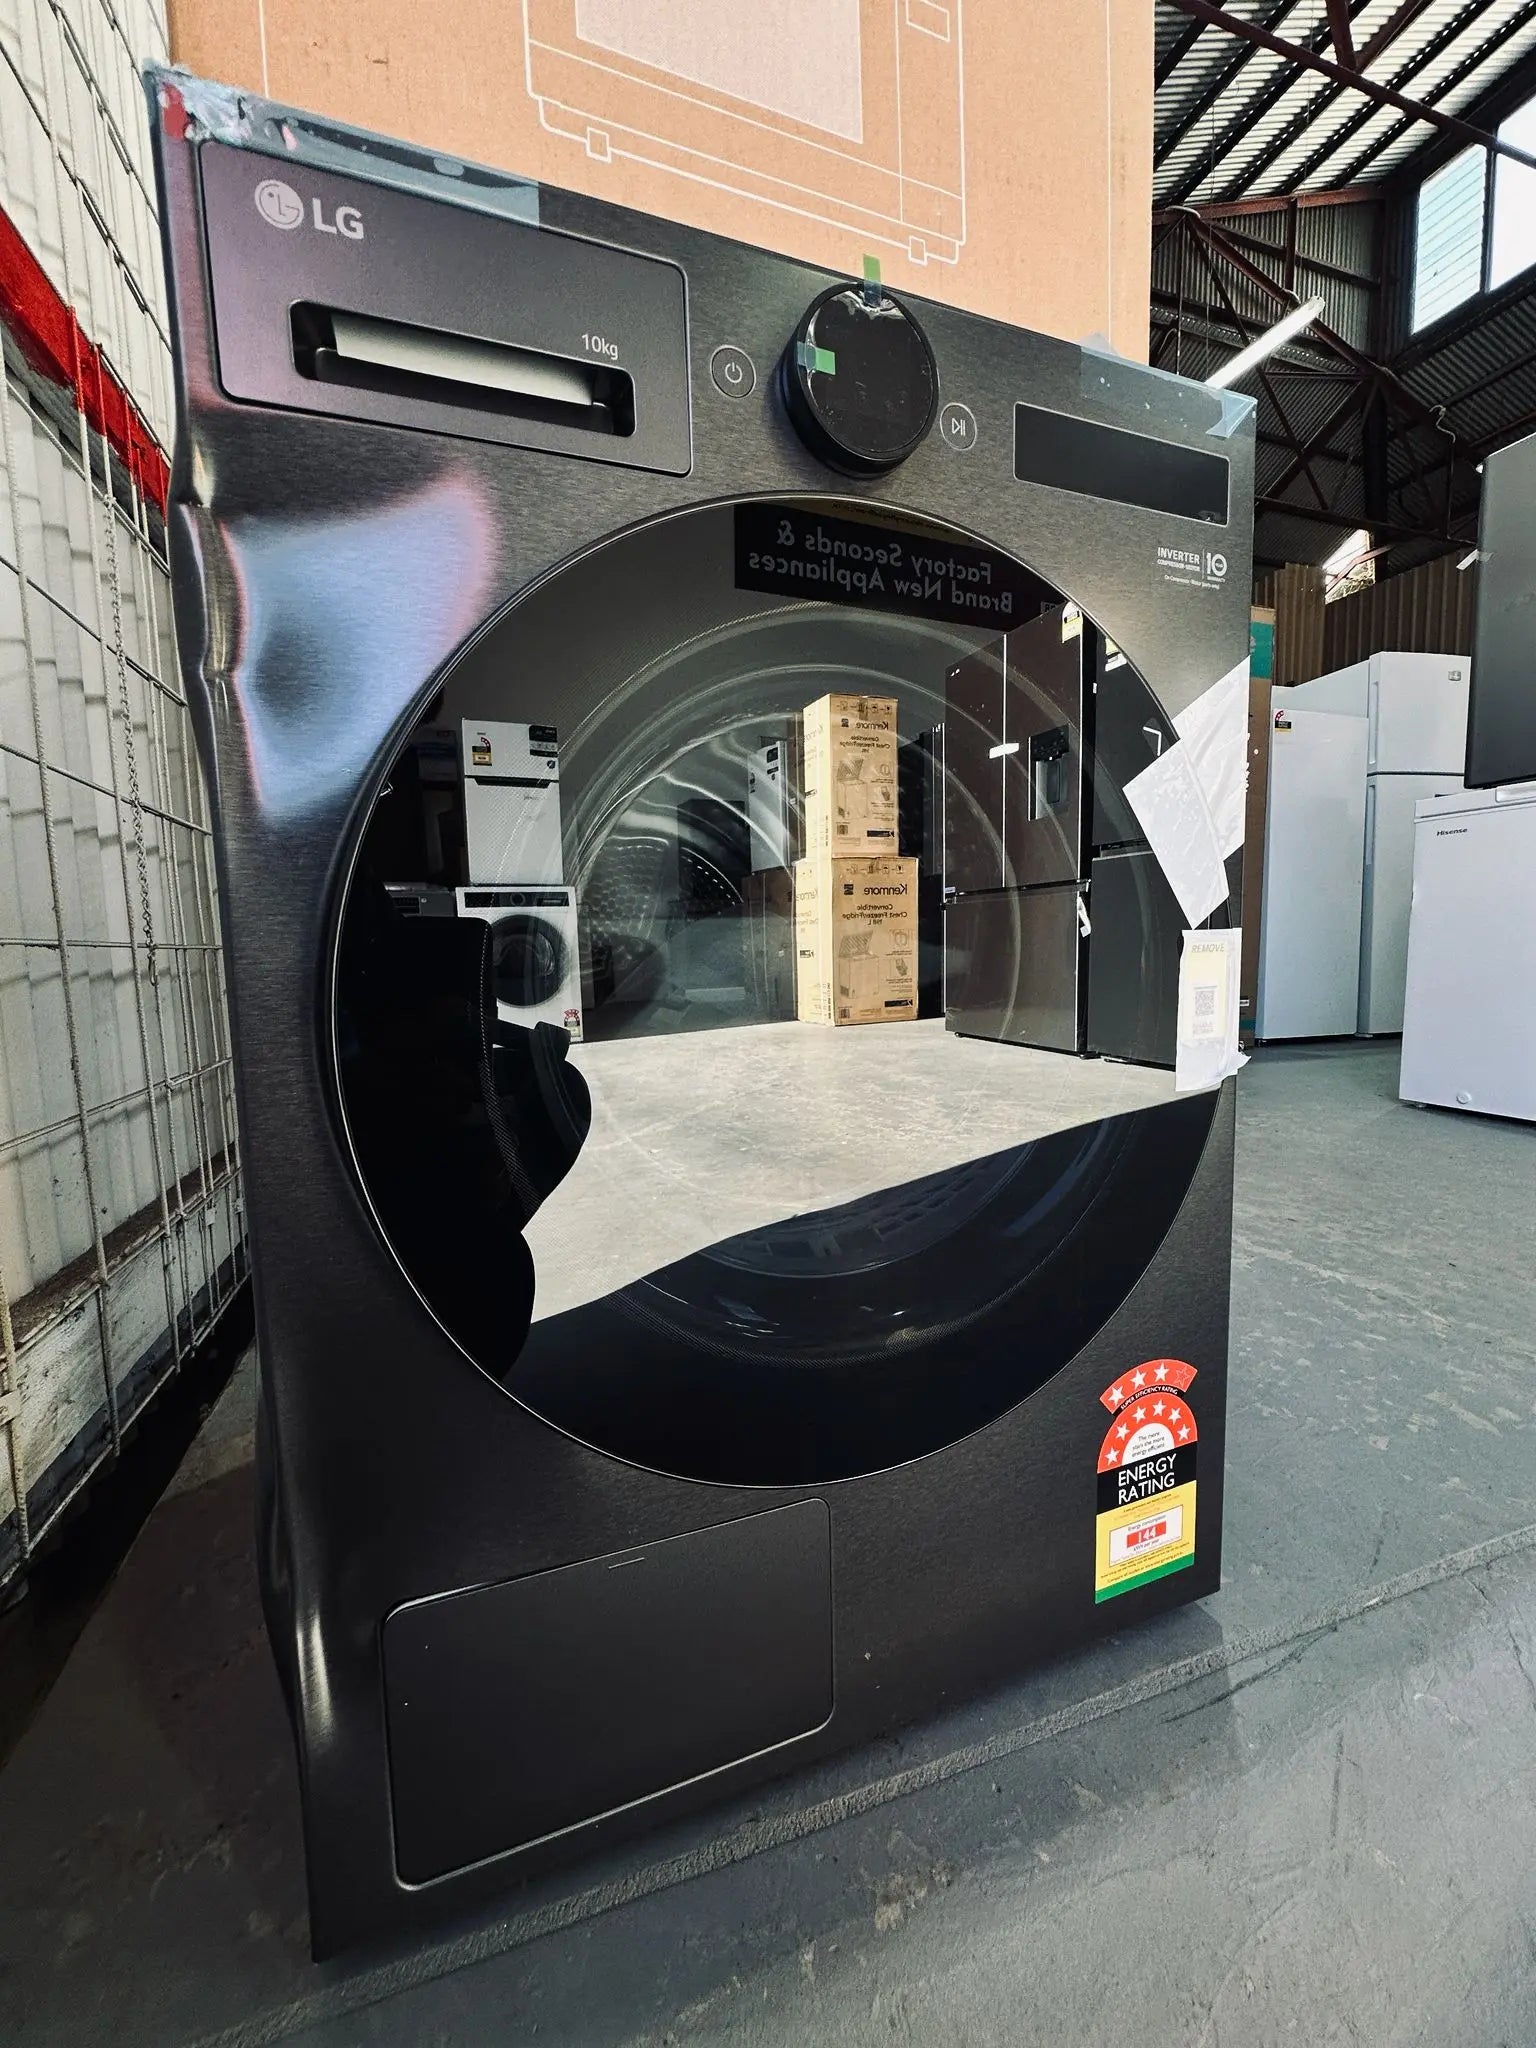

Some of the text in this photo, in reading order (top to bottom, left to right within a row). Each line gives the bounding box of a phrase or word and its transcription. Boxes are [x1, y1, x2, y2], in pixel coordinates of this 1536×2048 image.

[312, 197, 364, 240] LG
[581, 333, 618, 360] 10kg
[1157, 546, 1200, 565] INVERTER
[1436, 827, 1468, 837] Hisense
[1191, 943, 1225, 954] REMOVE
[1118, 1453, 1177, 1487] ENERGY
[1118, 1472, 1175, 1505] RATING
[1138, 1526, 1157, 1543] 144
